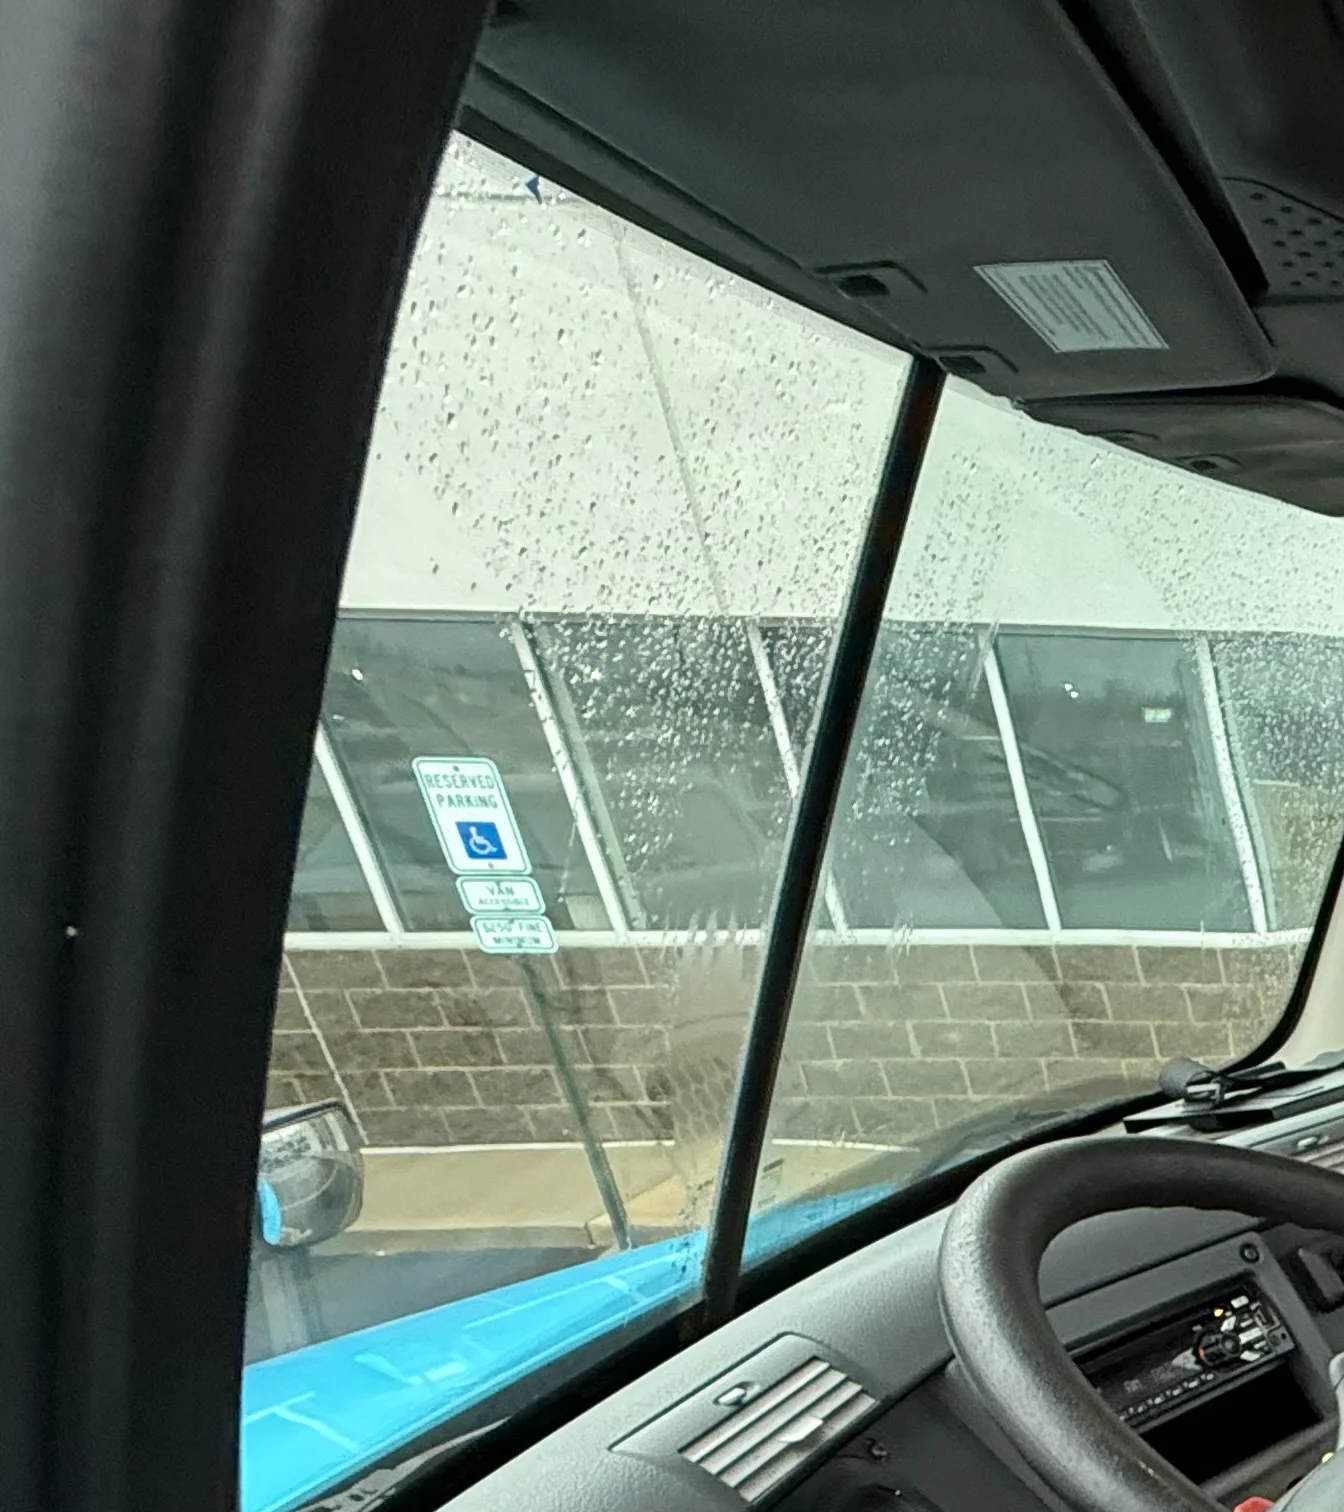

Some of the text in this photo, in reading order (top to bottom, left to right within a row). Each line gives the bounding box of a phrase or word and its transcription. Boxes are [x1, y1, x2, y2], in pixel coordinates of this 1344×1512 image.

[424, 774, 496, 790] RESERVED
[436, 794, 498, 808] PARKING
[485, 886, 515, 896] VAN
[518, 922, 544, 933] FINE
